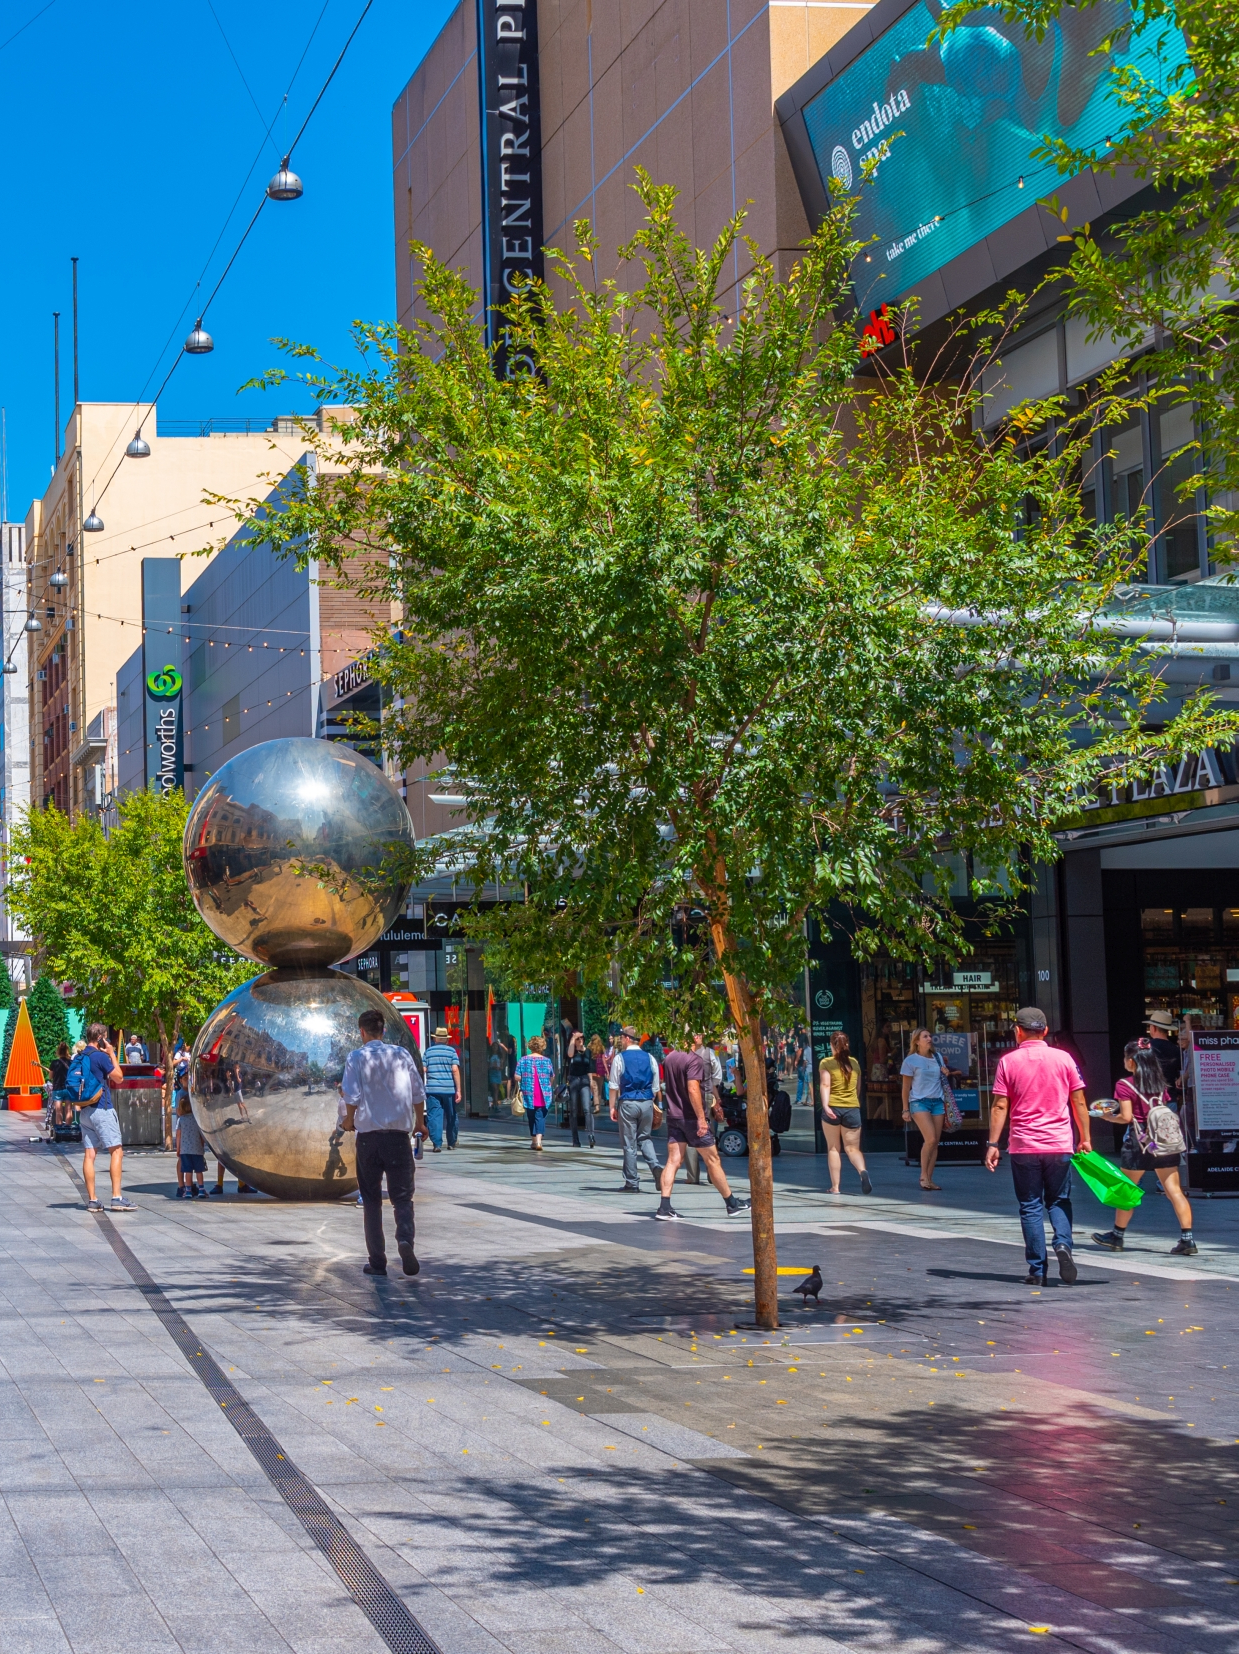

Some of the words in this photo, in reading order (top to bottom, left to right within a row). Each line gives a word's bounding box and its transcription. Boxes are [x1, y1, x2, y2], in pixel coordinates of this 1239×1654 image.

[851, 89, 911, 150] endota
[859, 138, 892, 178] spa
[498, 63, 534, 298] CENTRAL
[886, 242, 905, 261] take
[334, 652, 372, 698] SEPHOR
[358, 956, 378, 970] SEPHORA
[962, 974, 981, 982] HAIR
[1038, 970, 1050, 981] 100
[1198, 1036, 1218, 1045] miss
[1199, 1053, 1221, 1061] FREE
